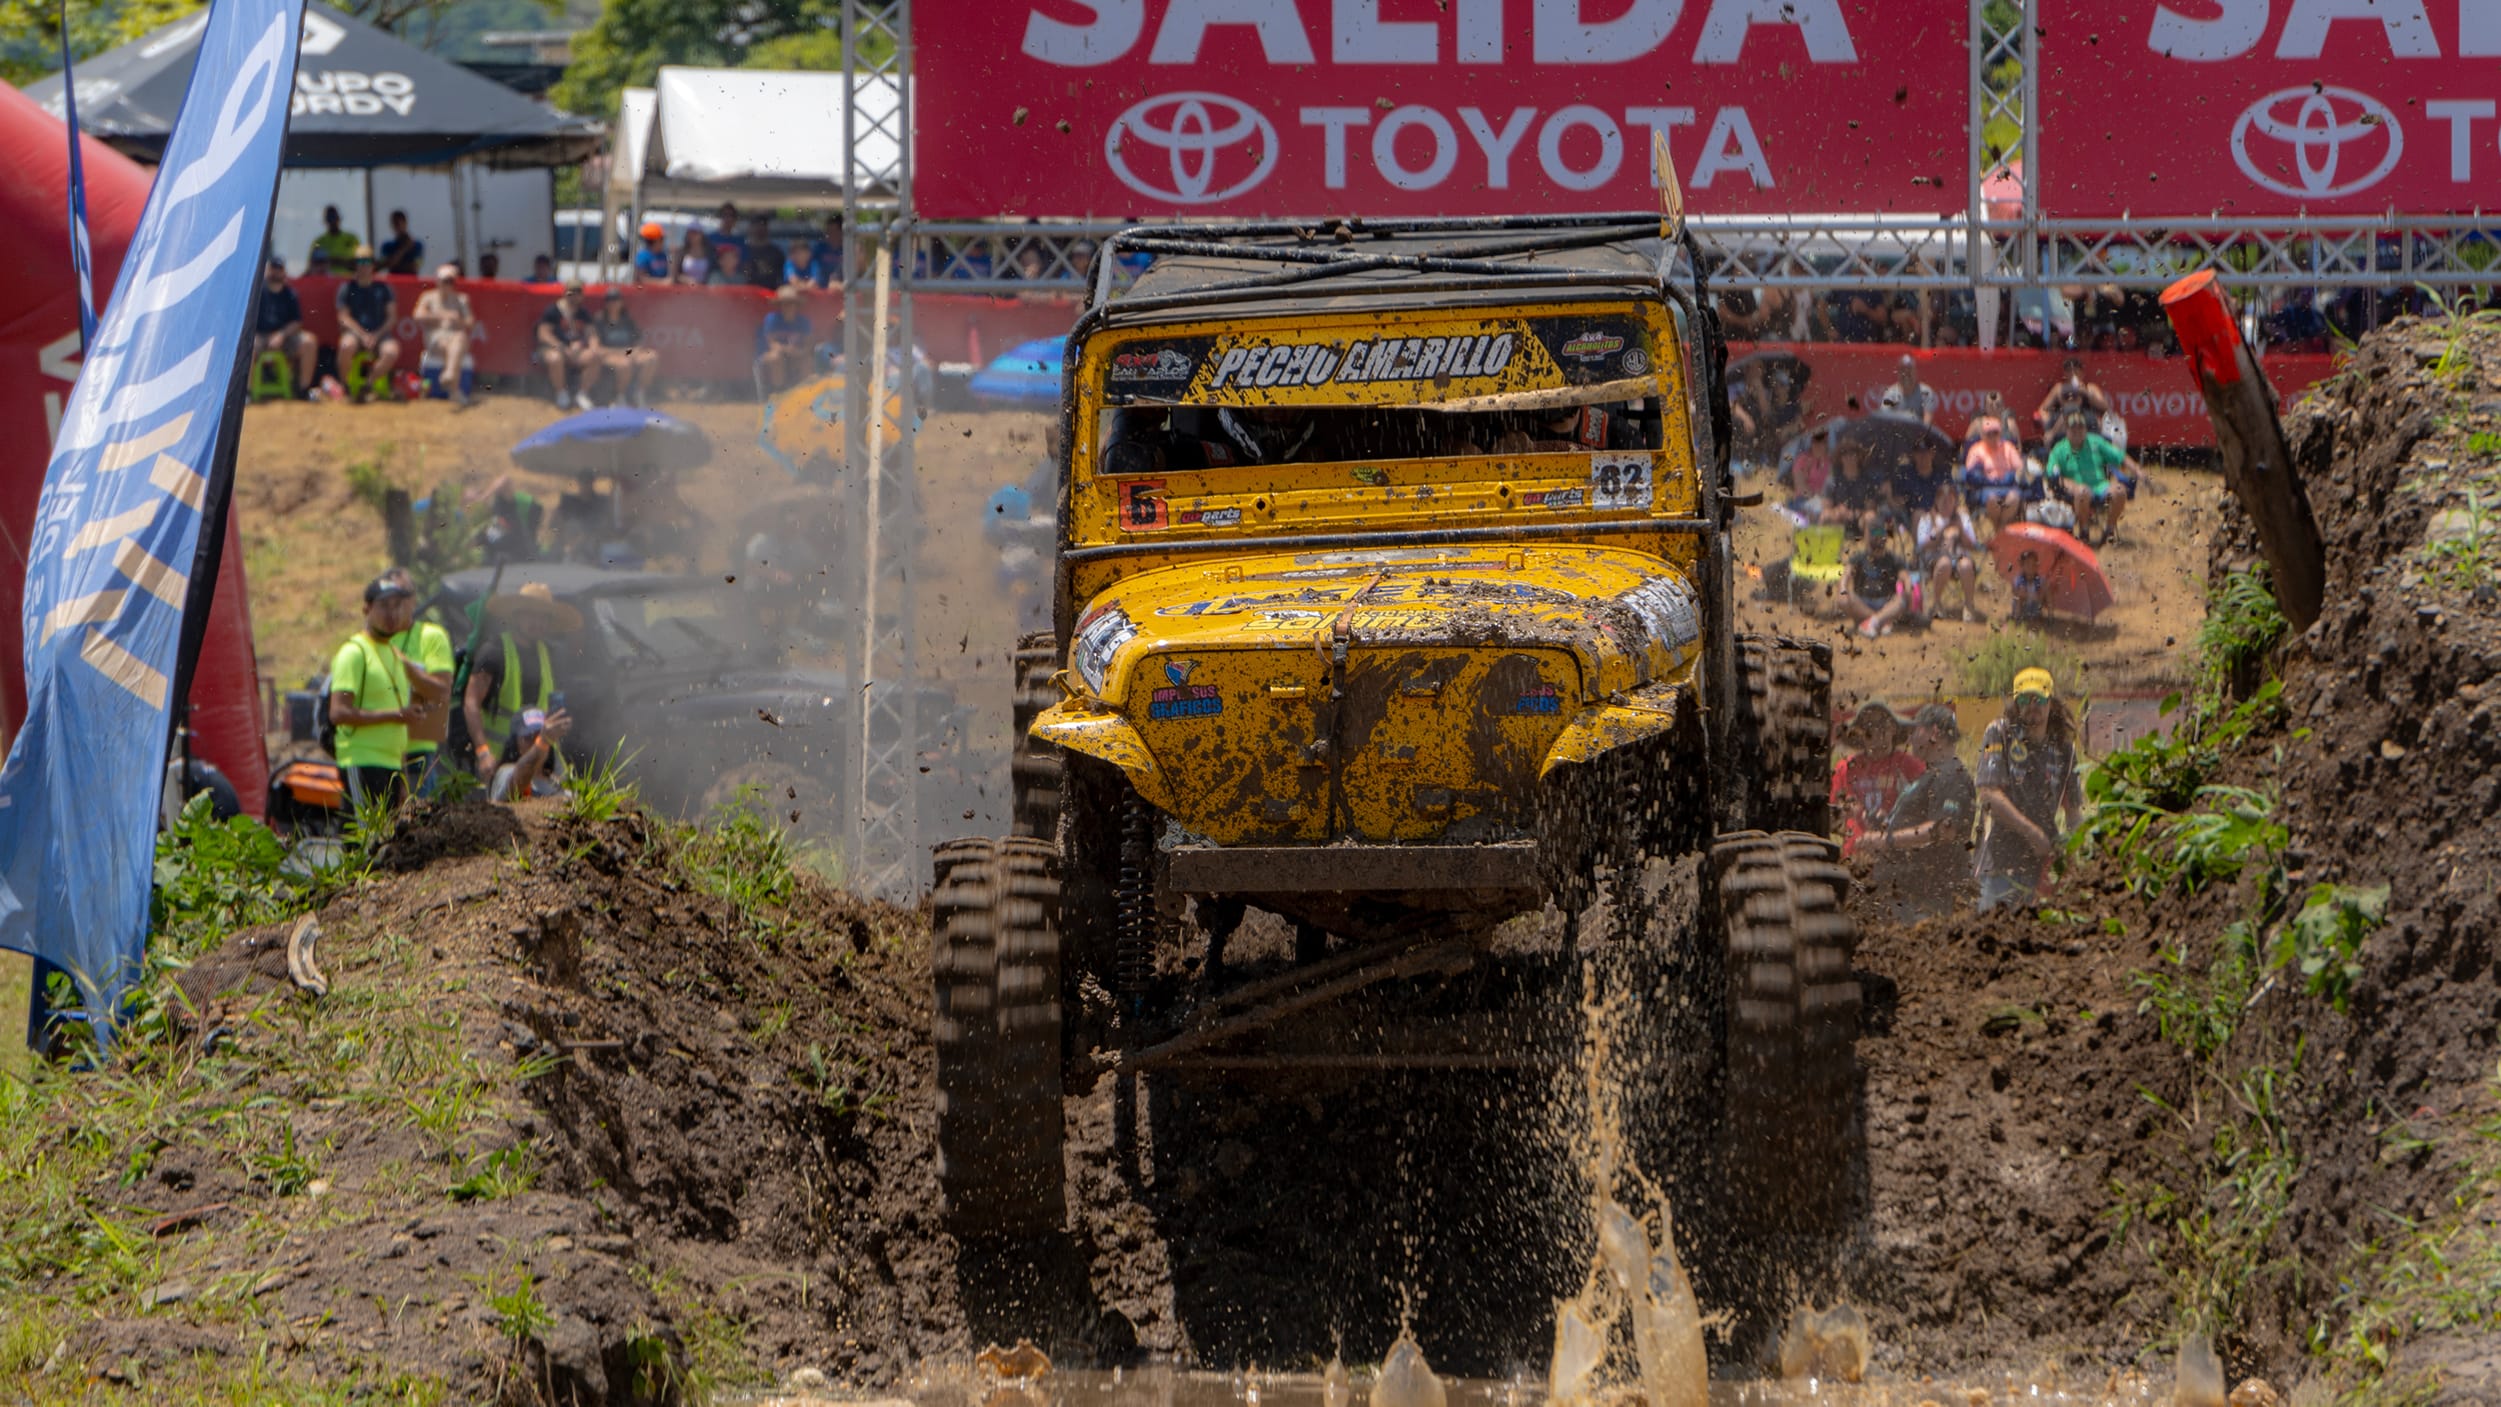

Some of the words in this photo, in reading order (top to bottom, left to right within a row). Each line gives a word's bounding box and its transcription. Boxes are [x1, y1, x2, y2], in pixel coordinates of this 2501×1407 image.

[297, 70, 415, 95] UPO
[1299, 105, 1776, 191] TOYOTA
[1336, 334, 1514, 383] AMARILLO
